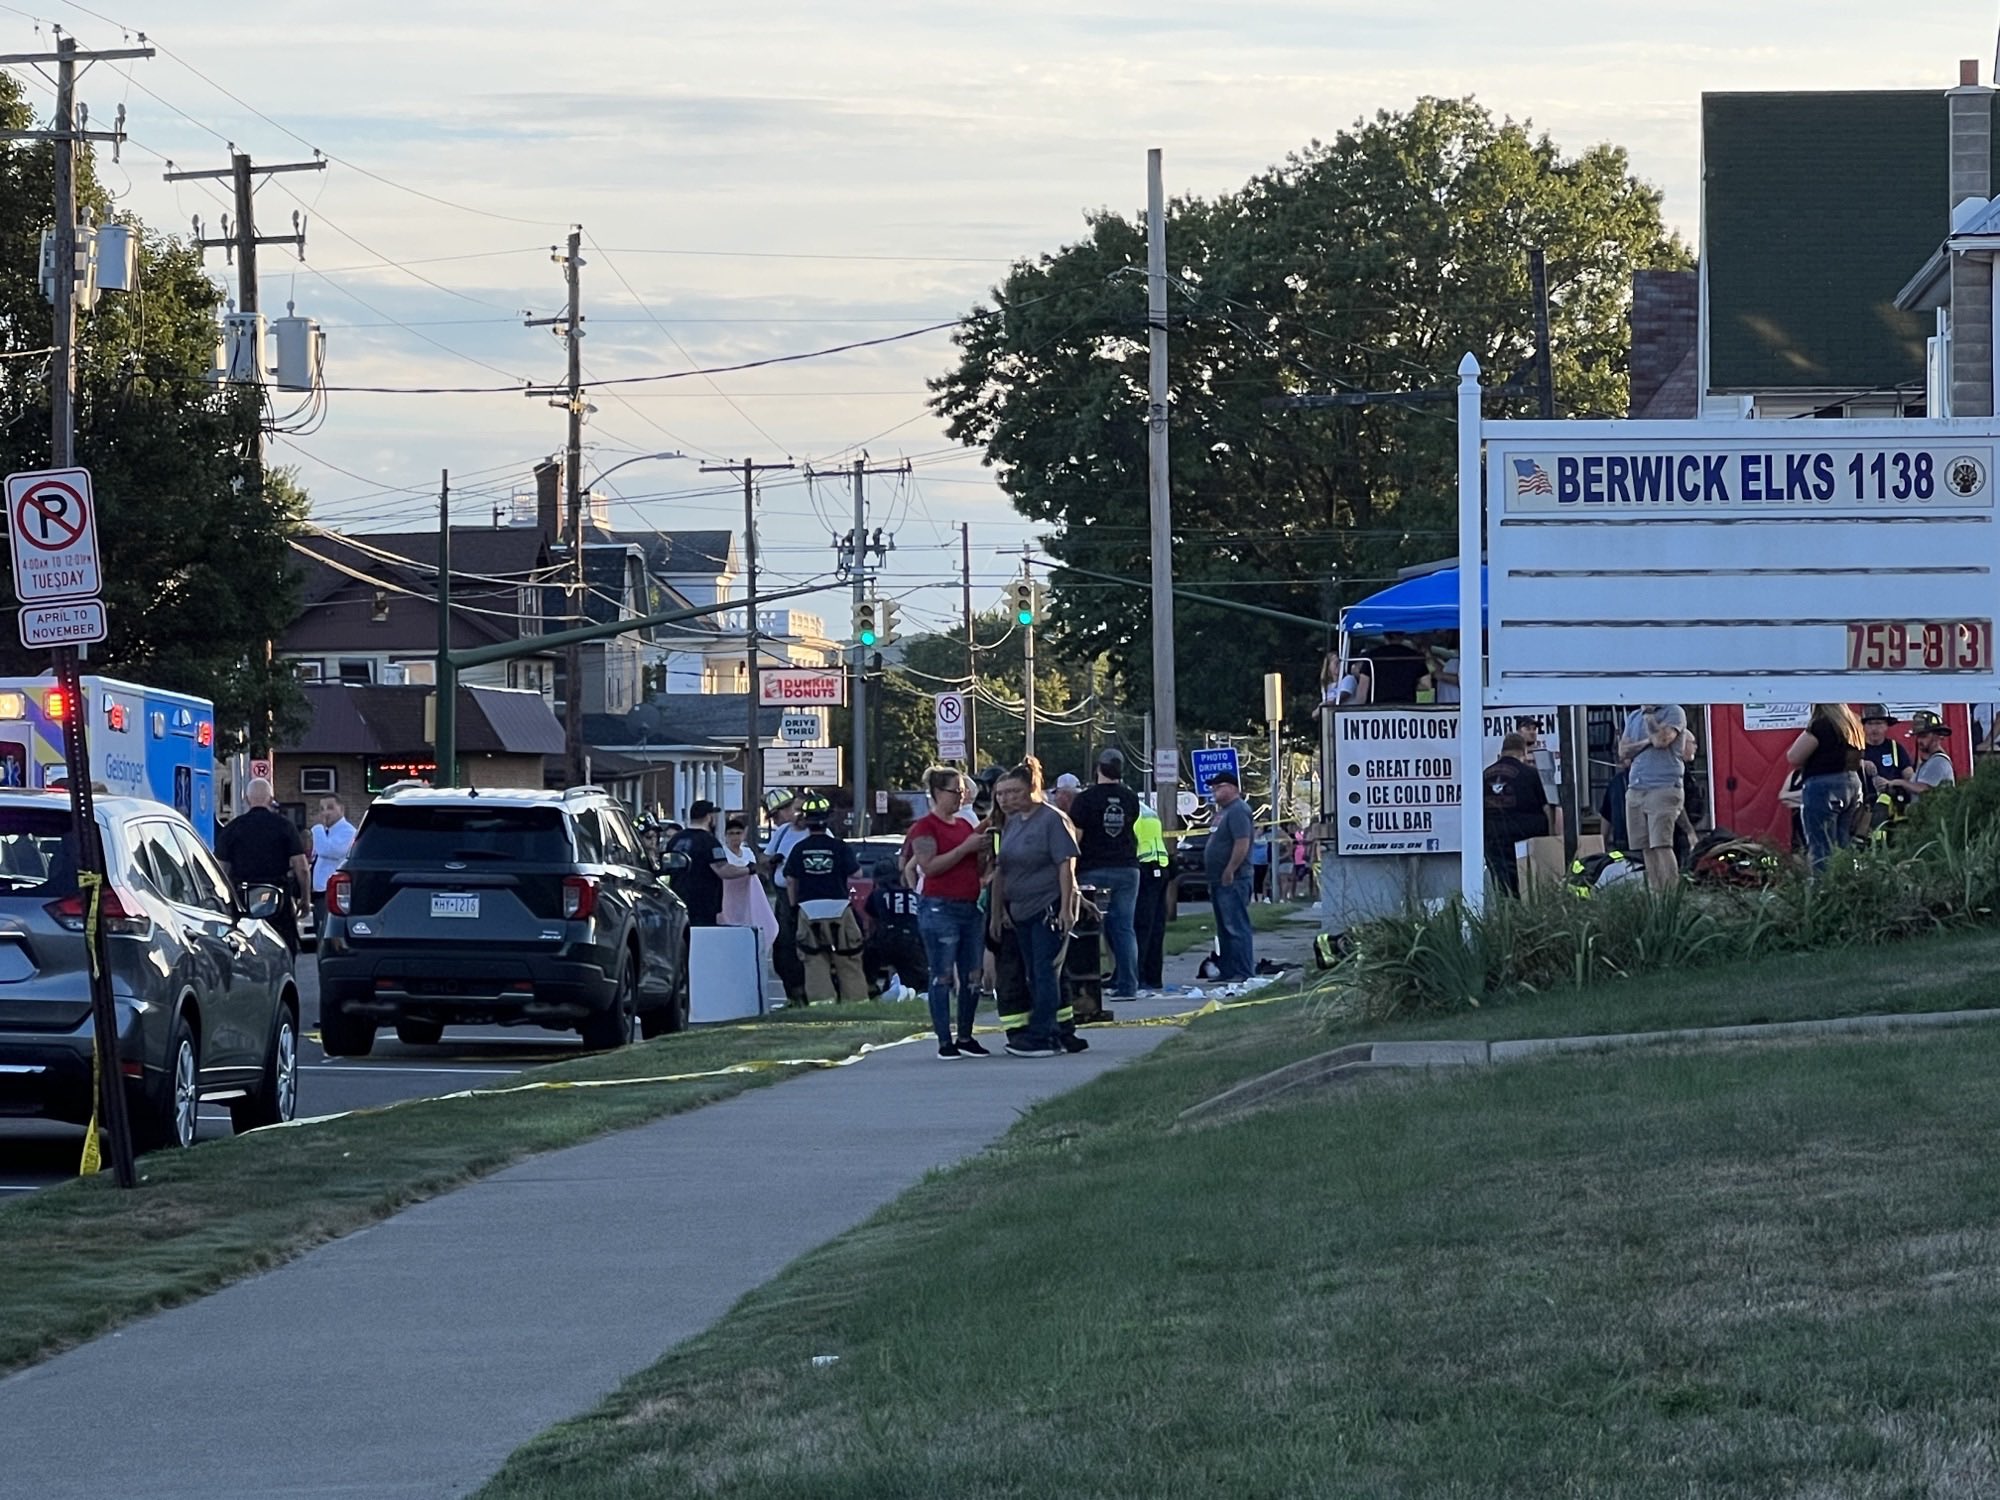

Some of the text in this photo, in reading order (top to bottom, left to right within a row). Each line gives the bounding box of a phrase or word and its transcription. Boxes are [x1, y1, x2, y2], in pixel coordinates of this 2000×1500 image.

[1557, 452, 1935, 503] BERWICK ELKS 1138
[52, 556, 61, 568] TO
[32, 570, 84, 589] TUESDAY
[37, 610, 87, 624] APRIL TO
[32, 624, 94, 638] NOVEMBER
[1847, 623, 1992, 669] 759-8131
[784, 689, 836, 698] DONUTS
[785, 719, 816, 727] DRIVE
[1343, 718, 1458, 740] INTOXICOLOGY
[1200, 752, 1228, 762] PHOTO
[105, 753, 144, 791] Geisinger
[1198, 762, 1233, 772] DRIVERS
[1366, 758, 1452, 778] GREAT FOOD
[1367, 784, 1462, 804] ICE COLD DRA
[1367, 811, 1432, 830] FULL BAR
[1345, 842, 1389, 850] FOLLOW
